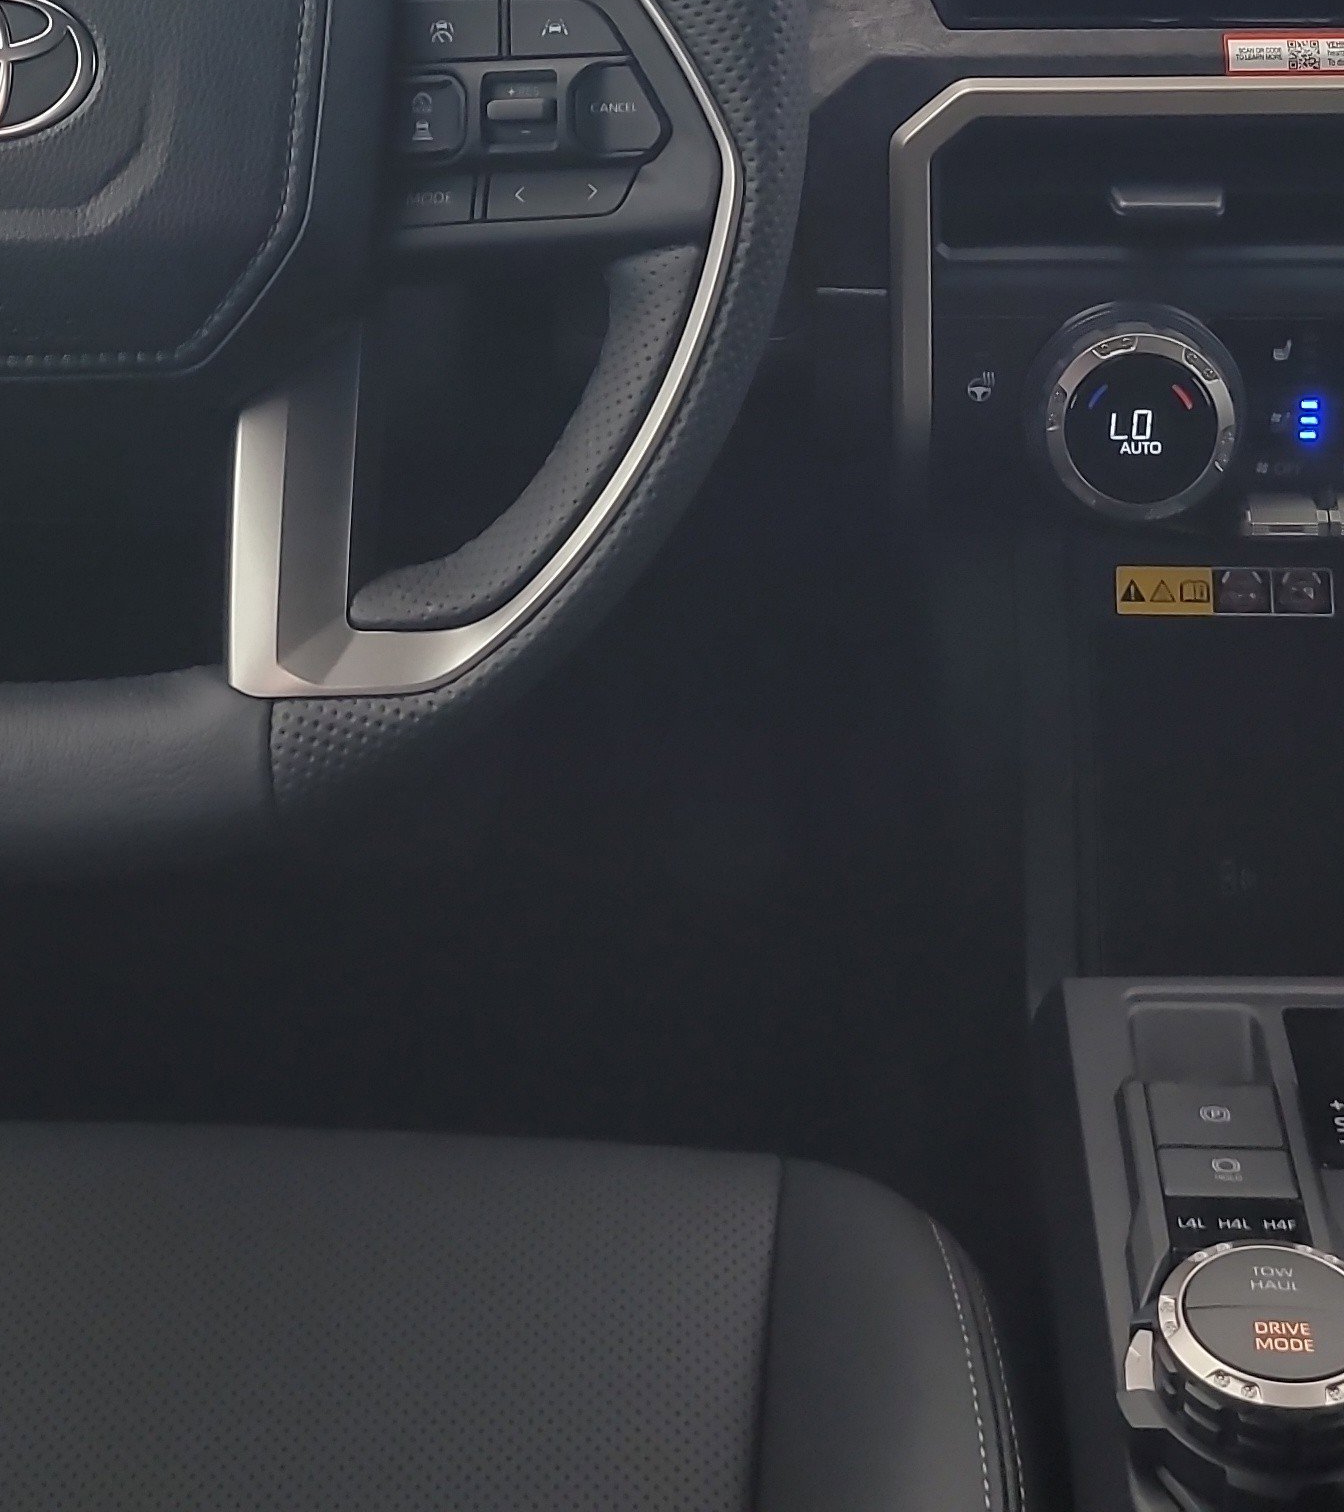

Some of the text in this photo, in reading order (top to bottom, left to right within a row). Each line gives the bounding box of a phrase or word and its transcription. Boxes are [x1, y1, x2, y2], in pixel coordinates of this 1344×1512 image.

[590, 101, 637, 114] CANCEL
[1109, 409, 1153, 442] LO
[1119, 440, 1162, 455] AUTO
[1177, 1216, 1297, 1231] L4L H4L H4F
[1252, 1265, 1293, 1278] TOW
[1250, 1278, 1297, 1292] HAUL
[1254, 1321, 1311, 1336] DRIVE
[1256, 1338, 1315, 1353] MODE
